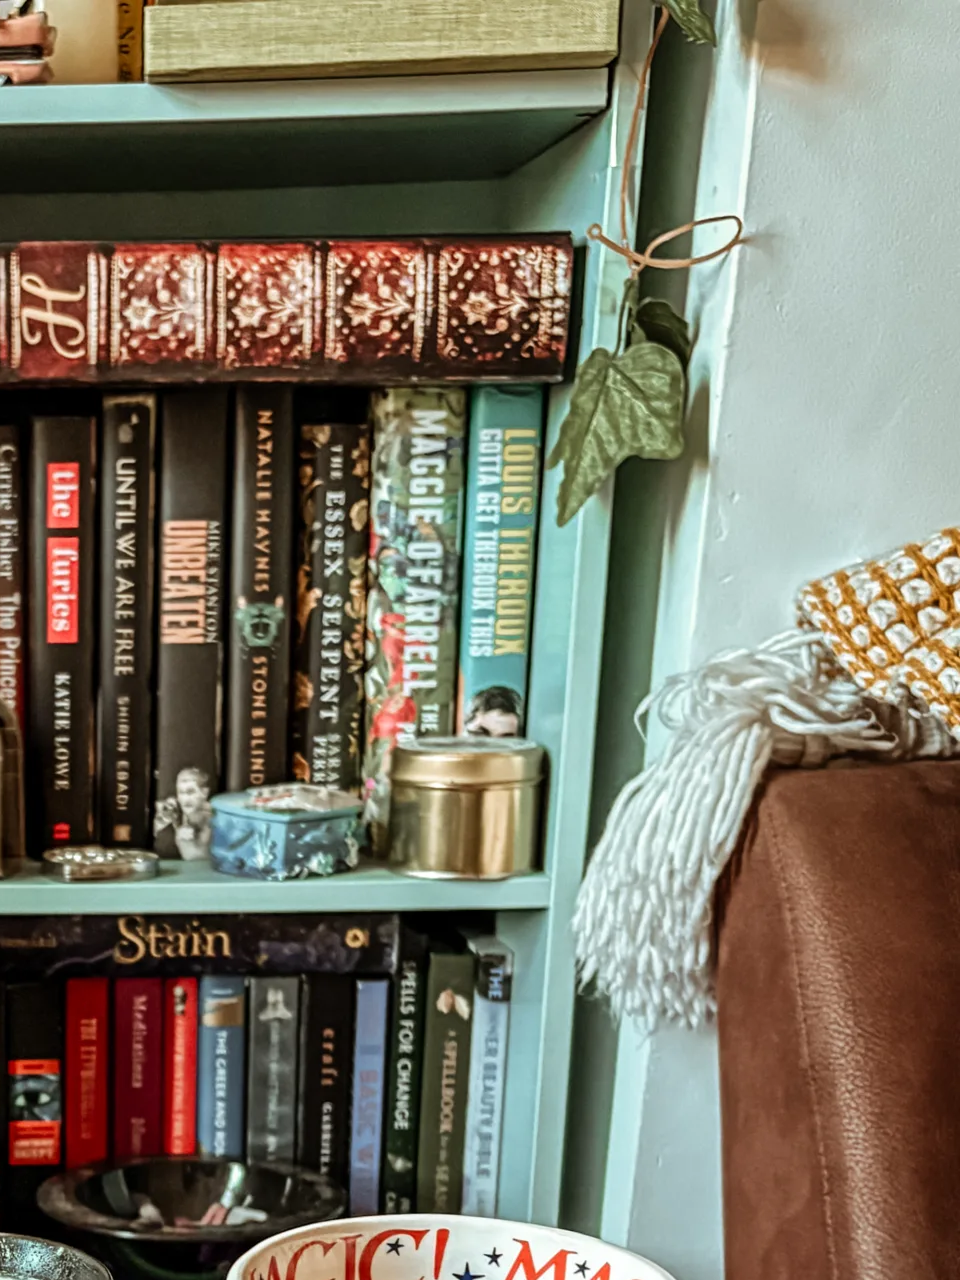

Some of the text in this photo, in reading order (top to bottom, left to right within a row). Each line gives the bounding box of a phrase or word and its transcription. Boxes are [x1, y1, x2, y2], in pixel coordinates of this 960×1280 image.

[253, 410, 273, 592] NATALIE HAYNES
[408, 410, 448, 525] MAGGIE
[52, 471, 78, 632] the furies
[113, 458, 136, 677] UNTIL WE ARE FREE
[160, 520, 208, 644] UNBEATEN
[205, 521, 220, 643] MIKE STANTON
[319, 444, 346, 724] THE ESSEX SERPENT
[469, 428, 503, 658] GOTTA GET THEROUX THIS
[493, 428, 538, 656] LOUIS THEROUX
[403, 541, 444, 697] O'FARRELL
[54, 672, 71, 790] KATIE LOWE
[116, 696, 130, 811] SHIRIN EBADI
[249, 656, 268, 785] STONE BLIND
[115, 915, 232, 965] Stain
[488, 967, 505, 1000] THE
[215, 1058, 227, 1098] GREEK
[216, 1031, 228, 1055] THE
[321, 1028, 338, 1085] craft
[393, 960, 416, 1131] SPELLS FOR CHANGE
[440, 1039, 458, 1134] SPELLBOOK
[481, 1049, 500, 1129] BEAUTY
[214, 1101, 226, 1129] AND
